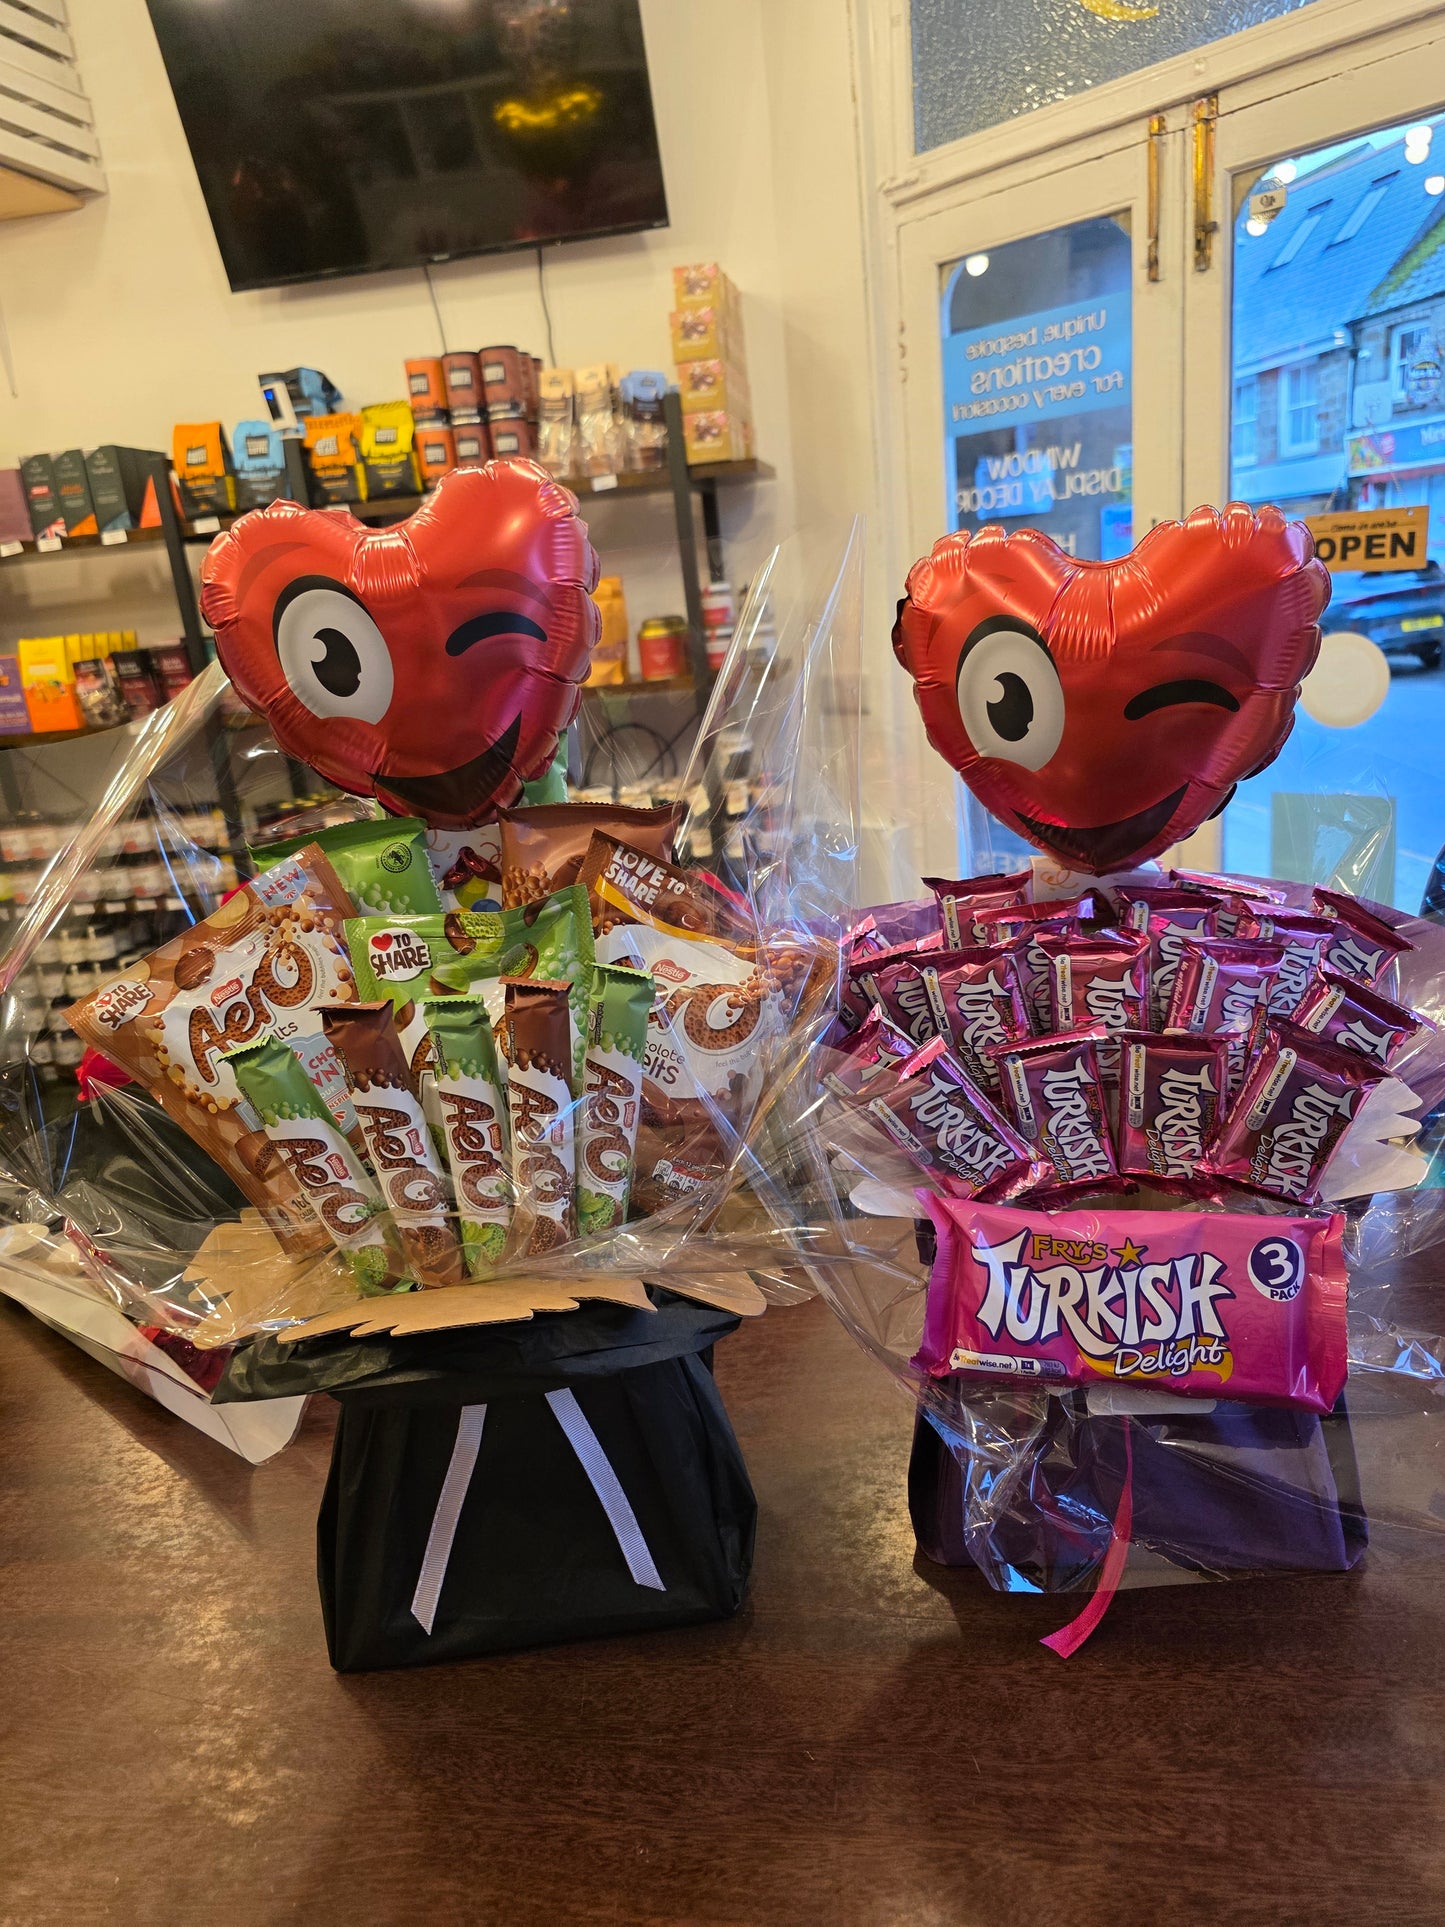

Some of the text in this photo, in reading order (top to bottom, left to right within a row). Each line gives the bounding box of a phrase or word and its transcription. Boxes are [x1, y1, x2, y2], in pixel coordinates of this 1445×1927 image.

[1315, 532, 1416, 562] OPEN
[262, 868, 299, 900] NEW
[604, 864, 658, 905] SHARE
[613, 846, 686, 895] LOVE TO
[370, 945, 429, 977] SHARE
[393, 933, 411, 948] TO
[98, 985, 155, 1029] SHARE
[111, 984, 128, 997] TO
[189, 942, 314, 1084] Aero
[584, 1058, 633, 1183] Aero
[910, 1072, 1015, 1180] TURKISH
[1041, 1055, 1110, 1180] TURKISH
[1154, 1063, 1219, 1180] TURKISH
[1273, 1083, 1357, 1197] TURKISH
[354, 1105, 444, 1211] Aero
[439, 1091, 510, 1209] Aero
[508, 1079, 568, 1203] Aero
[1042, 1135, 1072, 1181] Delight
[1145, 1129, 1167, 1175] Delight
[1250, 1134, 1275, 1184] Delight
[272, 1138, 370, 1236] Aero
[939, 1151, 986, 1186] Delight
[1031, 1233, 1108, 1265] FRY'S
[1260, 1243, 1294, 1285] 3
[971, 1227, 1236, 1356] TURKISH
[1270, 1283, 1300, 1300] PACK
[1113, 1335, 1228, 1376] Delight
